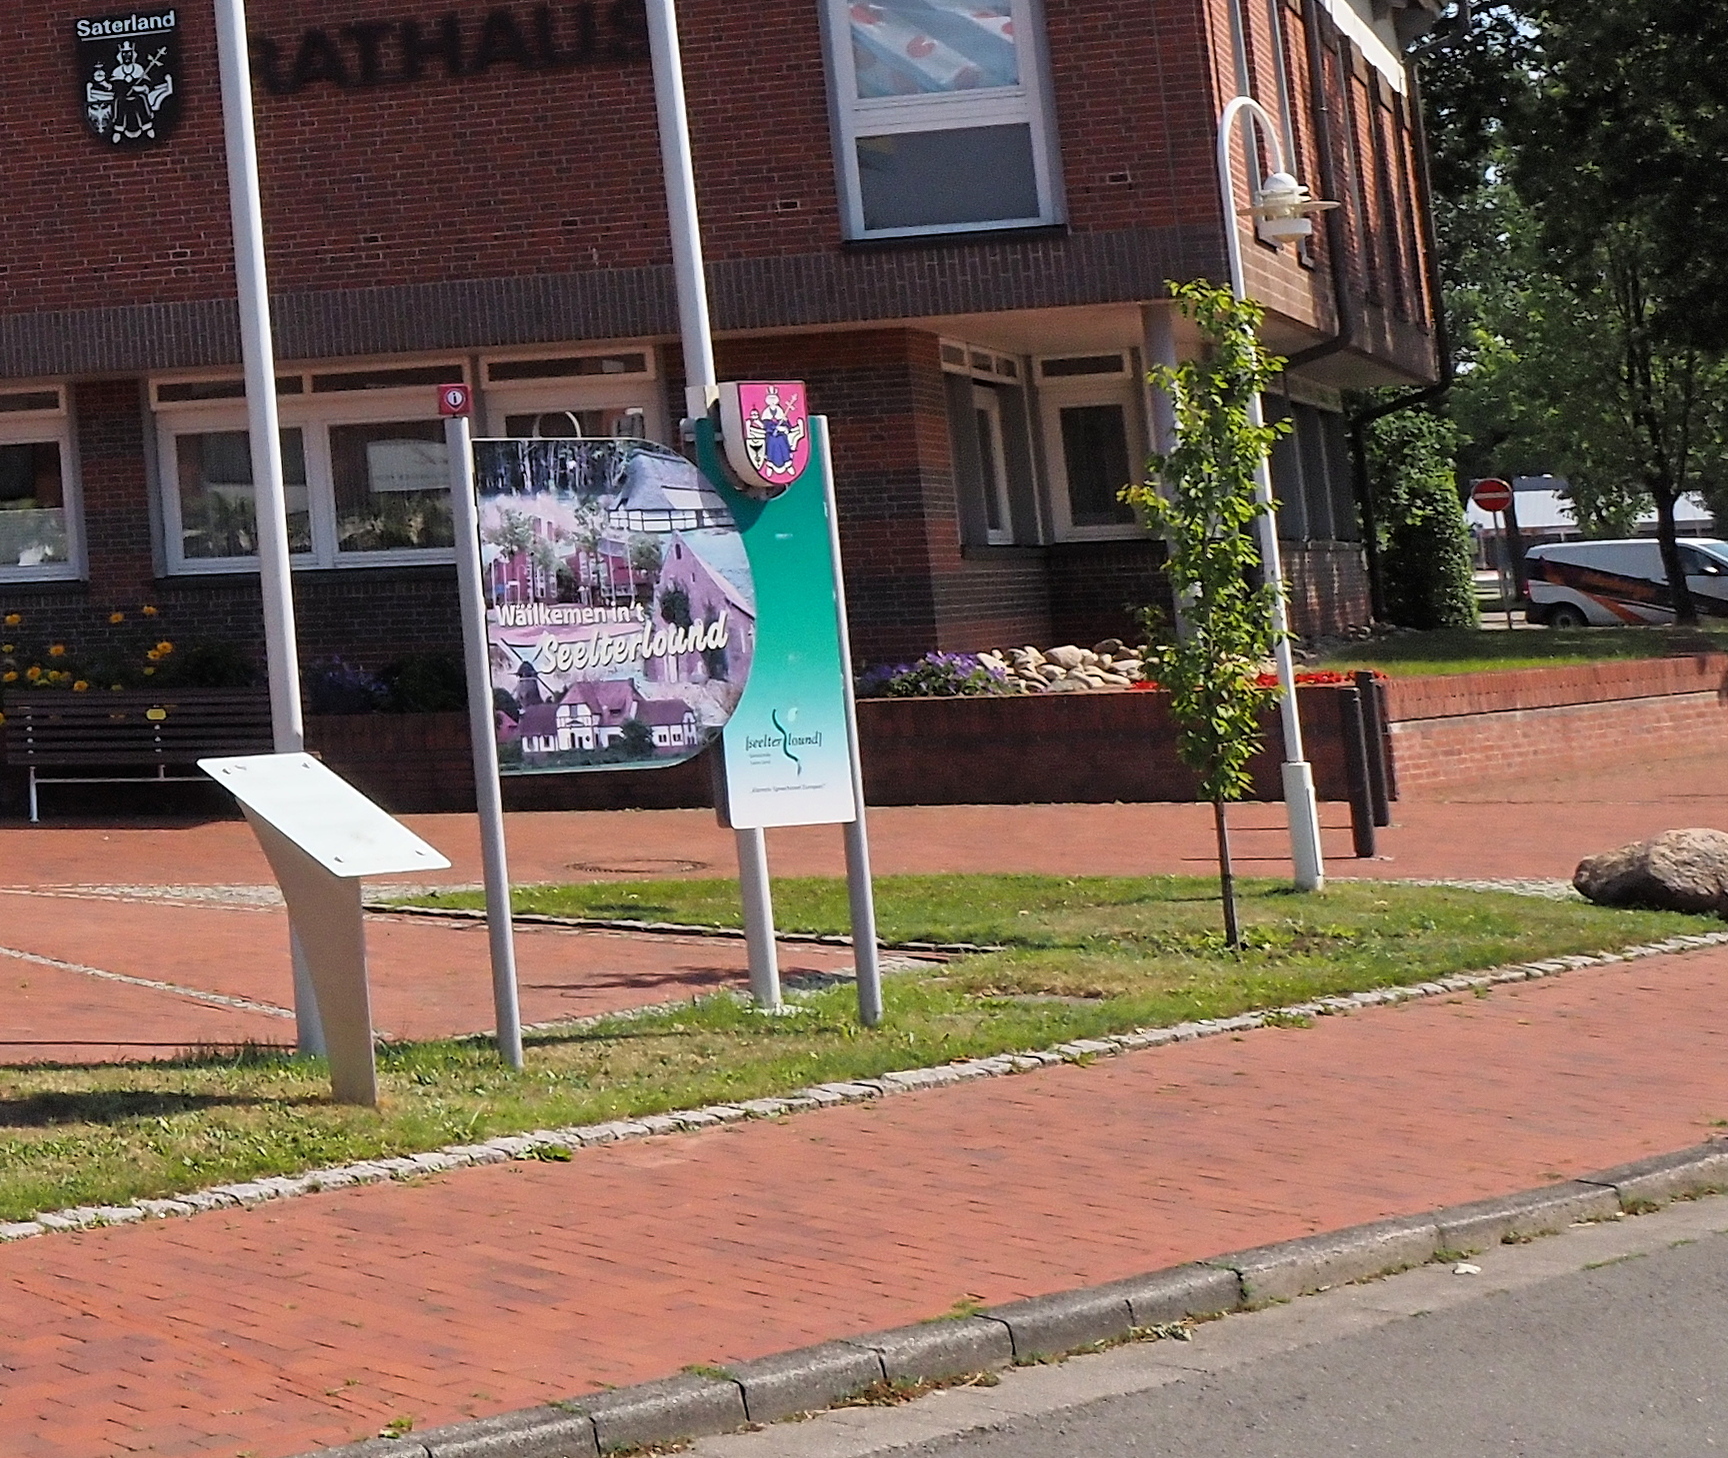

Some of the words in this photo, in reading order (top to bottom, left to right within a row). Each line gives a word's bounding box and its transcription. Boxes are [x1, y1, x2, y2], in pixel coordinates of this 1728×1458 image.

[76, 9, 176, 37] Saterland
[496, 603, 607, 627] Wäilkemen
[539, 610, 729, 674] Seelterlound
